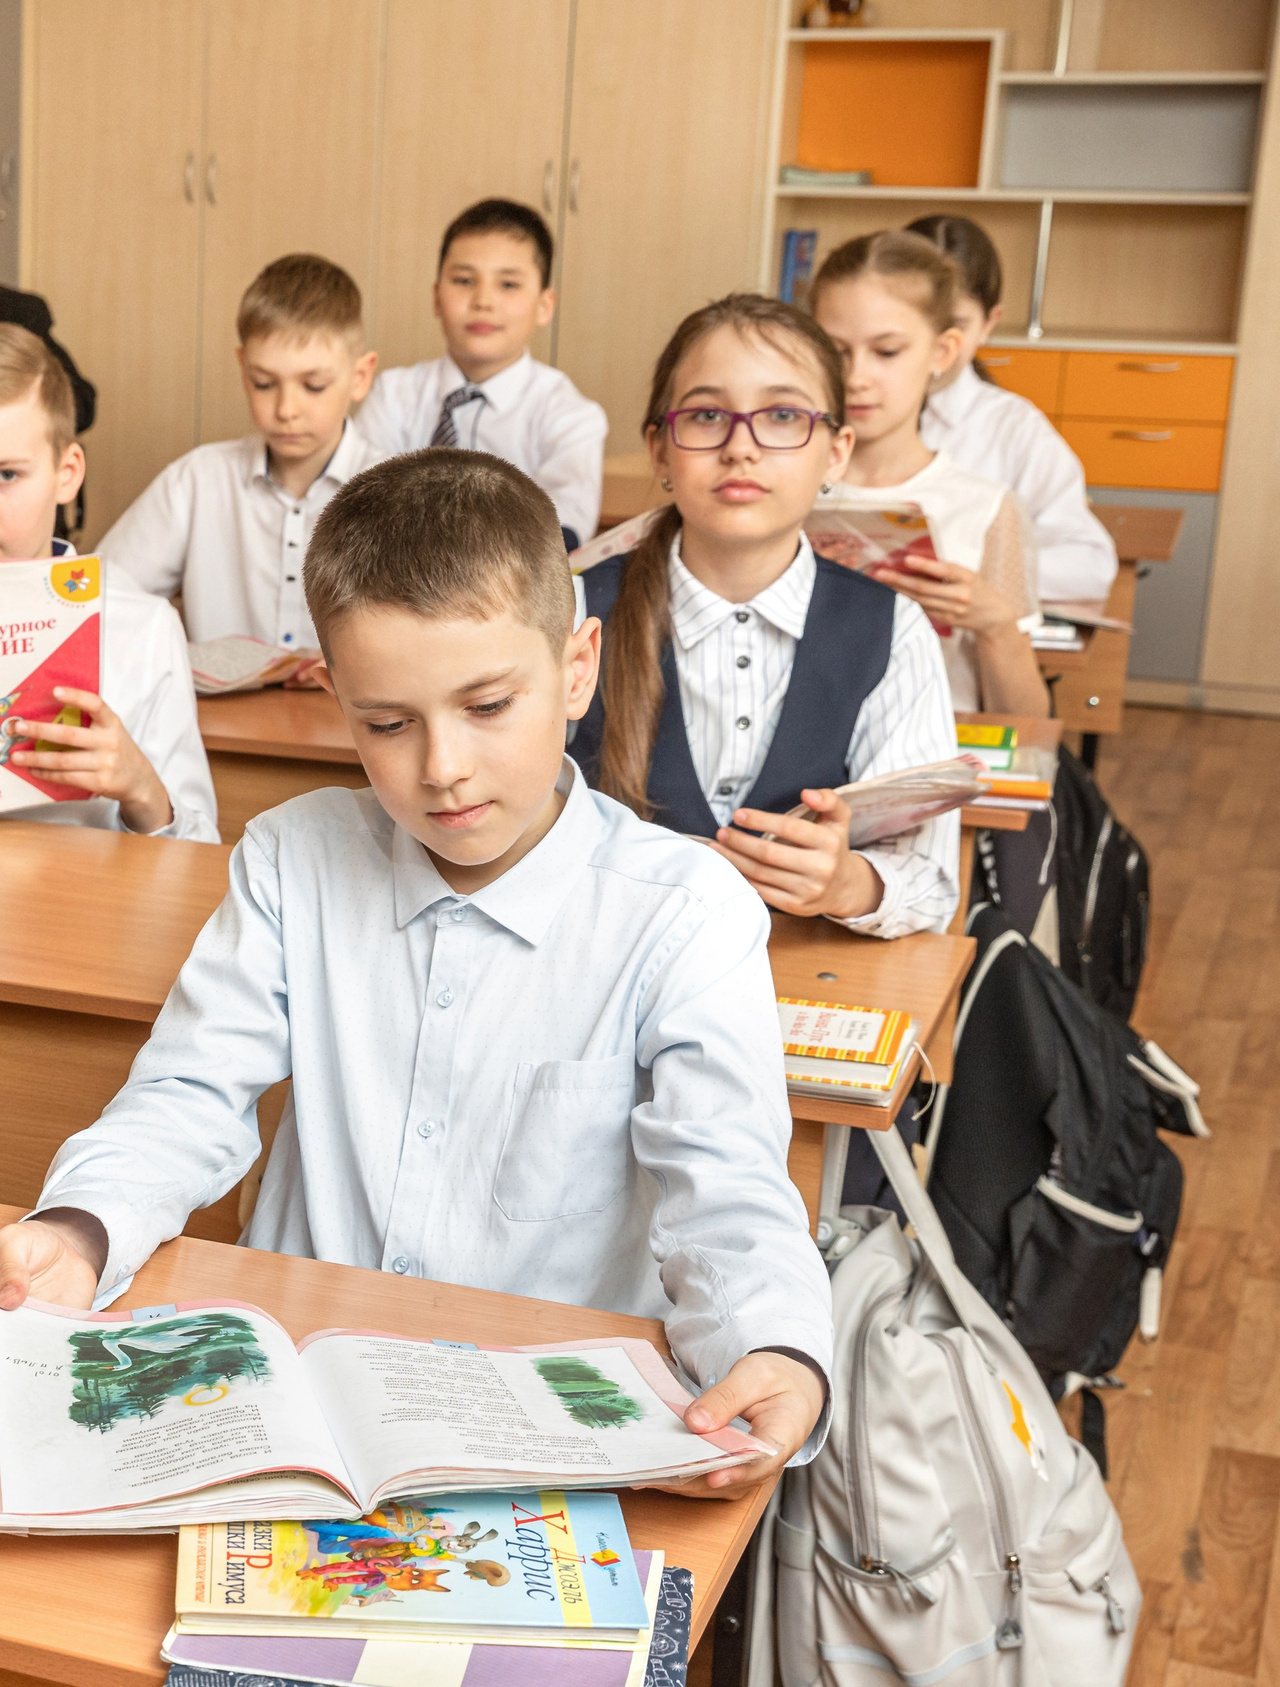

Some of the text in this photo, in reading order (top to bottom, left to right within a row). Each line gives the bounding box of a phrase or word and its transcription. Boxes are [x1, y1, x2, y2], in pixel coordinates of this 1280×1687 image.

[198, 1405, 238, 1417] равнину
[209, 1408, 244, 1419] бросал
[129, 1417, 192, 1436] бесконечную
[164, 1418, 203, 1431] глазами
[215, 1416, 261, 1427] Молодой
[121, 1412, 260, 1447] Расправлял крыло могучее
[200, 1423, 263, 1439] Надвигалась
[122, 1431, 159, 1443] молнии
[173, 1438, 193, 1447] туча
[188, 1435, 223, 1447] солнца
[211, 1434, 246, 1445] видала
[115, 1441, 156, 1453] облаком
[180, 1445, 205, 1454] оком
[202, 1443, 229, 1453] чуяла
[238, 1444, 270, 1453] Снова
[122, 1446, 182, 1466] золотистого
[229, 1450, 256, 1459] когда
[195, 1458, 223, 1469] гроза
[253, 1521, 272, 1551] азки
[504, 1501, 568, 1601] Харрис
[217, 1522, 273, 1604] шки Римуса
[549, 1547, 587, 1604] Джоэль
